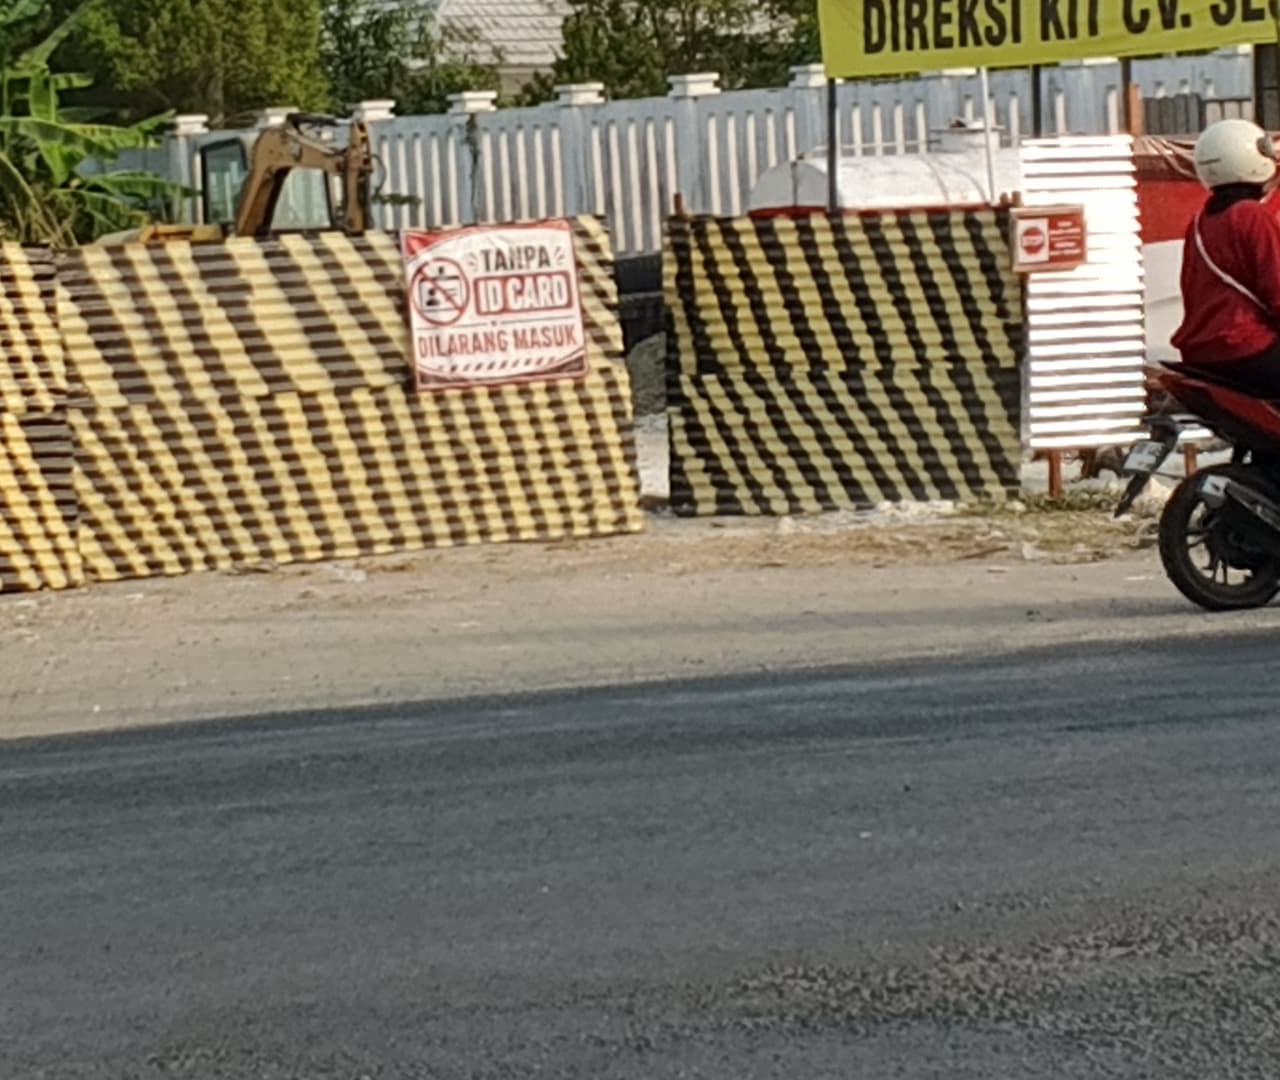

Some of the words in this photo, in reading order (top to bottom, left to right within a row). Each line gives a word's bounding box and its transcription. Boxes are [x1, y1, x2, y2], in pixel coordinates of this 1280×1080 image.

[478, 279, 503, 313] ID
[506, 274, 569, 311] CARD
[418, 330, 509, 359] DILARANG
[513, 324, 578, 350] MASUK
